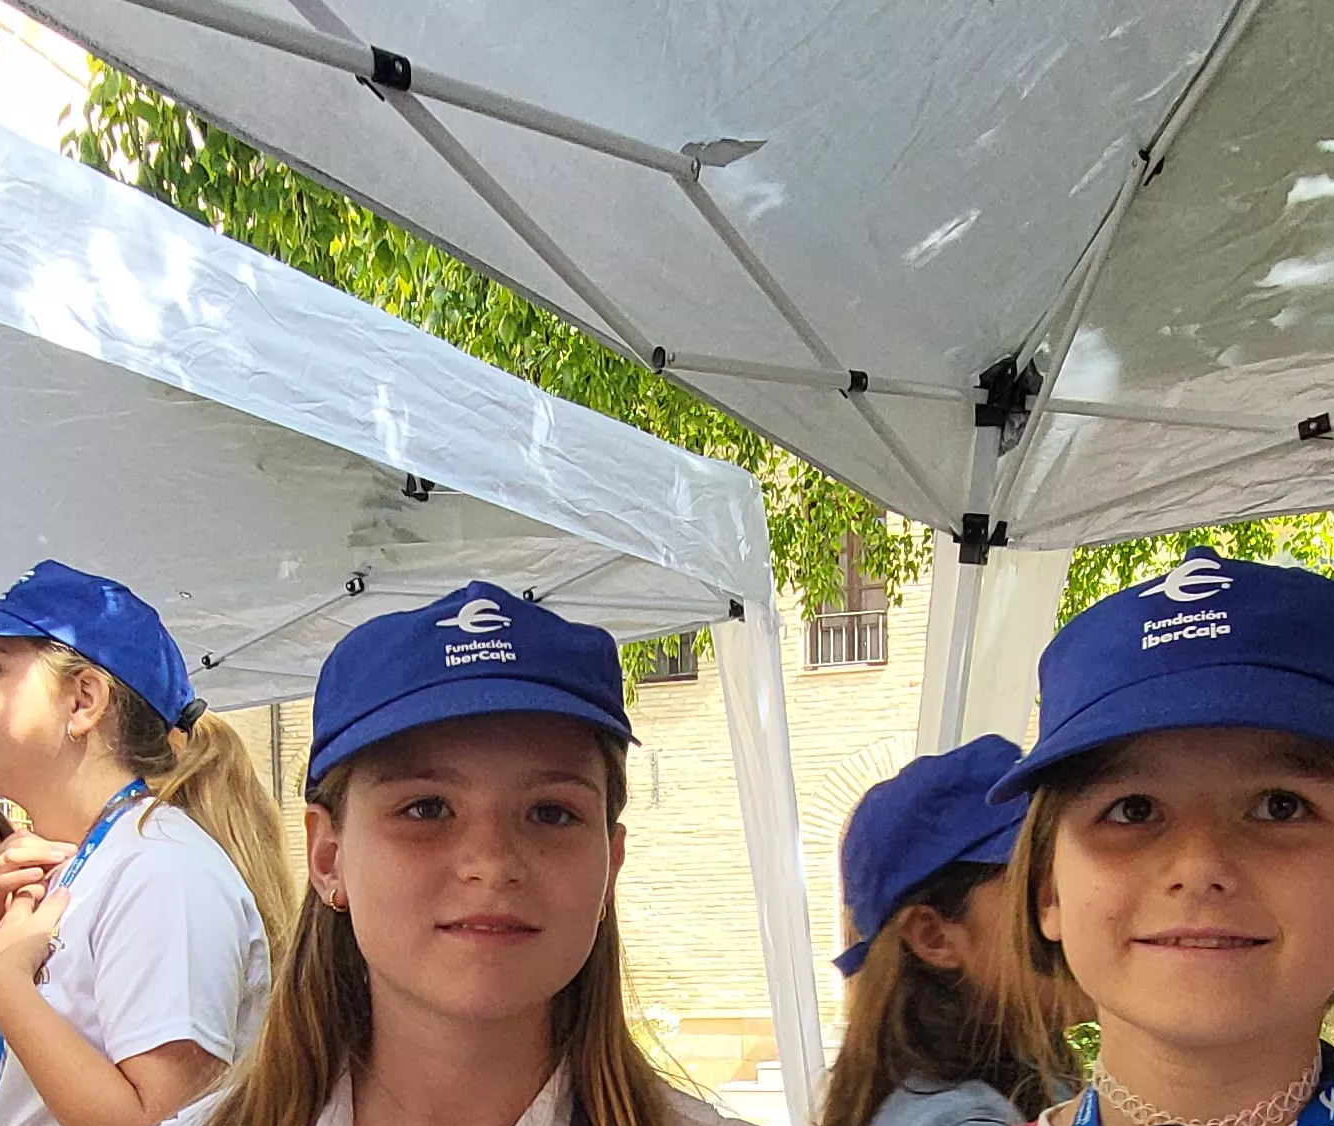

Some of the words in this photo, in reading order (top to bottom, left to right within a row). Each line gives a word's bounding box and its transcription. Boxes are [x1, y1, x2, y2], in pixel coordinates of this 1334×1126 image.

[1143, 610, 1228, 634] Fundación
[445, 640, 512, 655] Fundación
[1141, 623, 1231, 650] iberCaja
